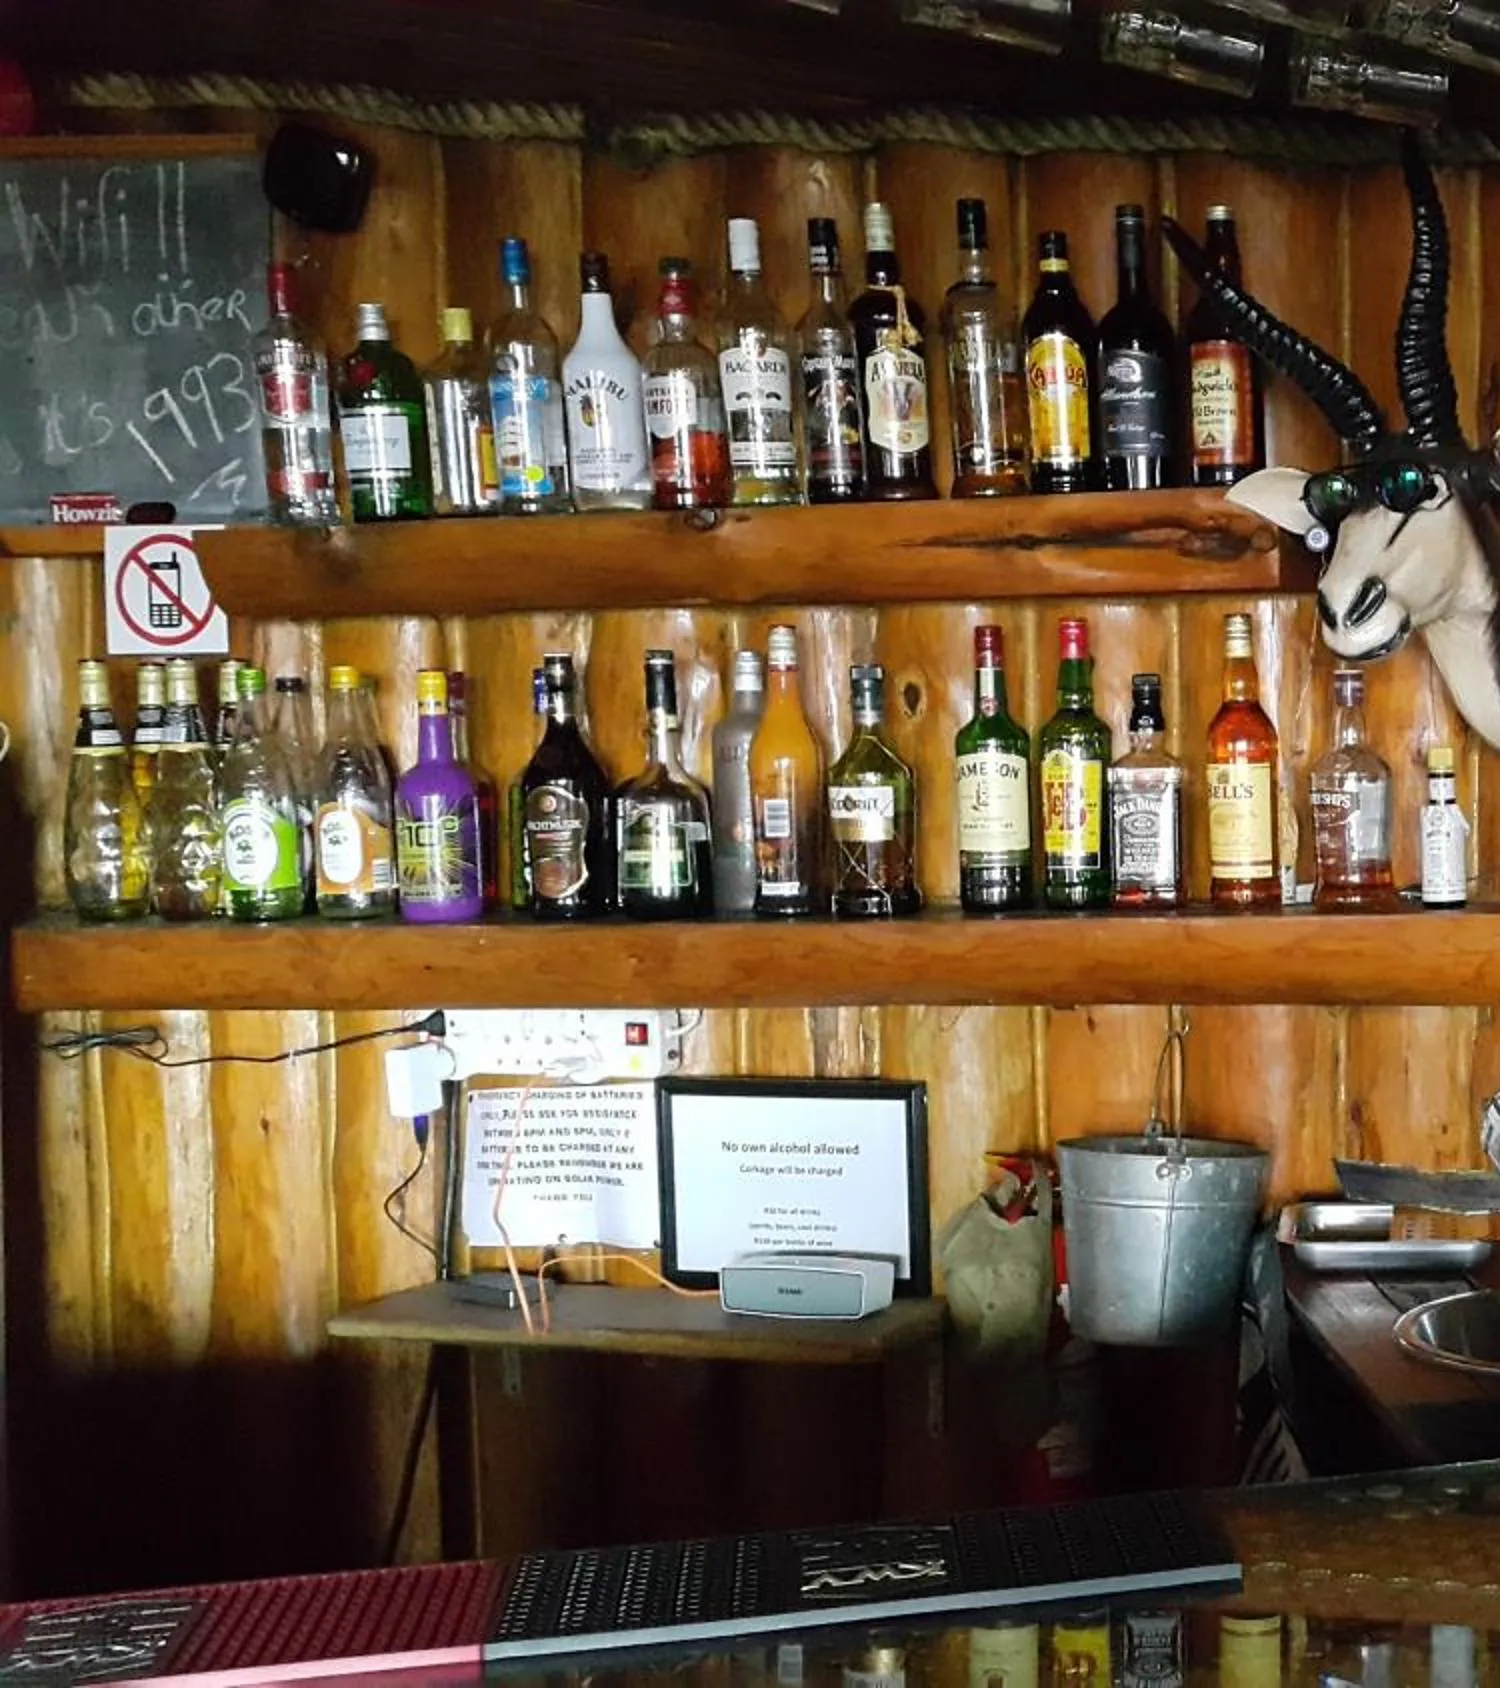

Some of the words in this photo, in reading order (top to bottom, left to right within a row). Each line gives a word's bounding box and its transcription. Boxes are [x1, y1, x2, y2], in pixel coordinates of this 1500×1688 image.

[725, 360, 787, 374] BACARDI
[567, 374, 631, 402] MALBU
[126, 353, 257, 484] 1993
[721, 1141, 739, 1153] No
[741, 1144, 766, 1154] own
[769, 1141, 811, 1155] alcohol
[813, 1142, 860, 1156] allowed
[778, 1163, 793, 1175] will
[795, 1164, 806, 1175] be
[807, 1165, 843, 1178] charged
